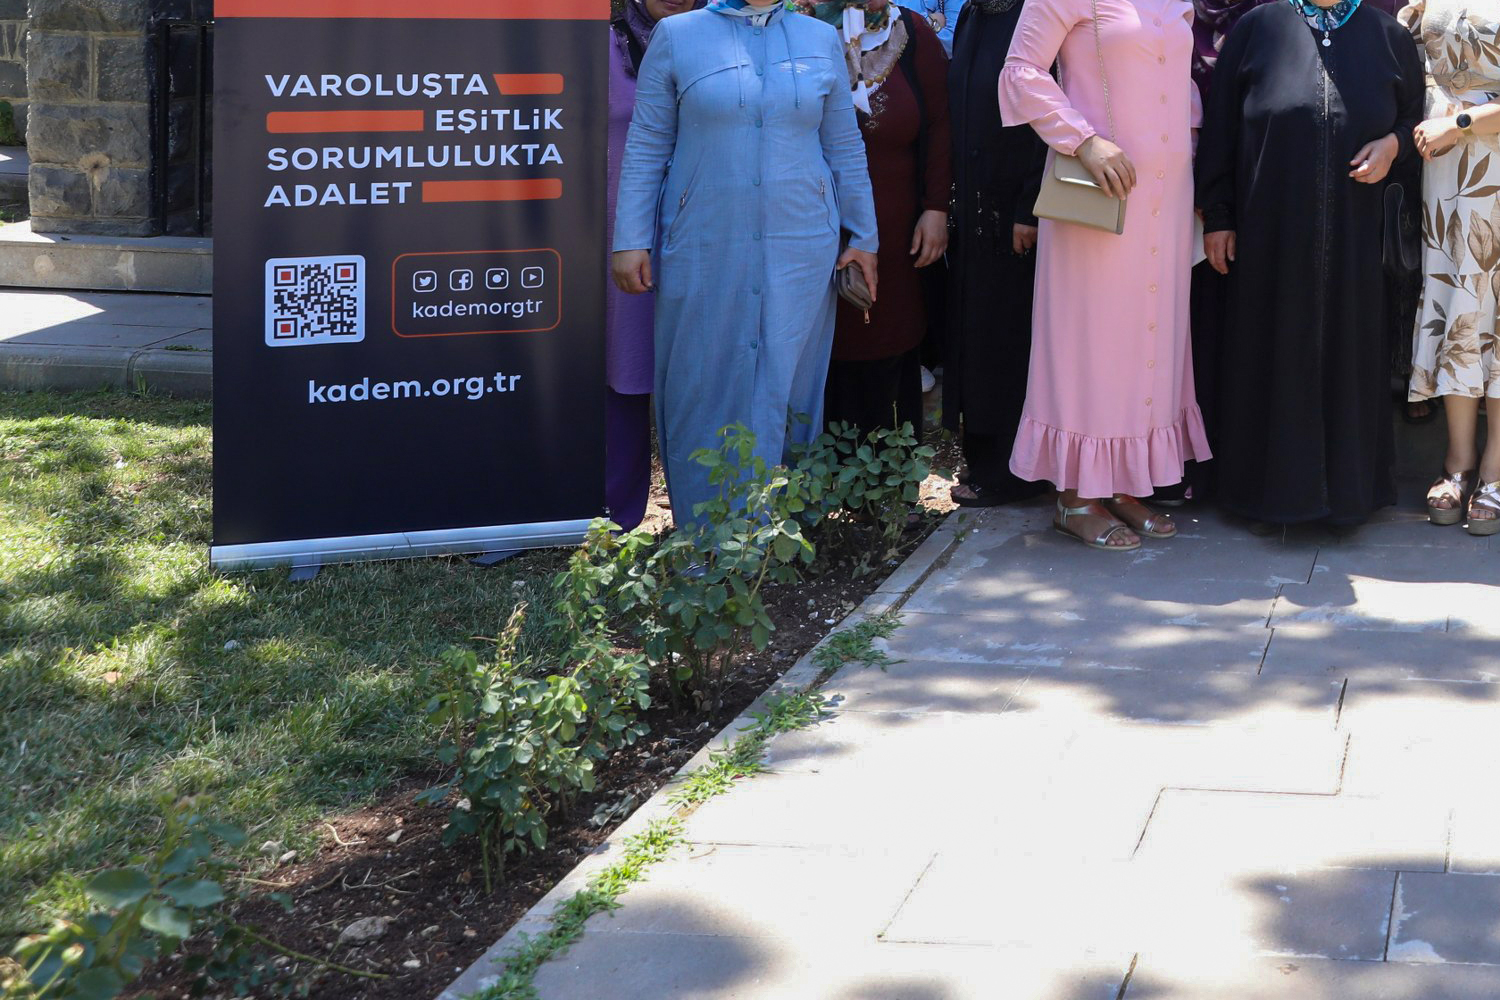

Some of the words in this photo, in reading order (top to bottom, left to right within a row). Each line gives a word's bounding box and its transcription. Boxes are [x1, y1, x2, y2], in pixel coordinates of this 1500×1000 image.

[265, 73, 489, 98] VAROLUŞTA
[267, 143, 564, 171] SORUMLULUKTA
[263, 181, 413, 207] ADALET
[412, 299, 544, 319] kademorgtr
[309, 372, 522, 404] kadem.org.tr
